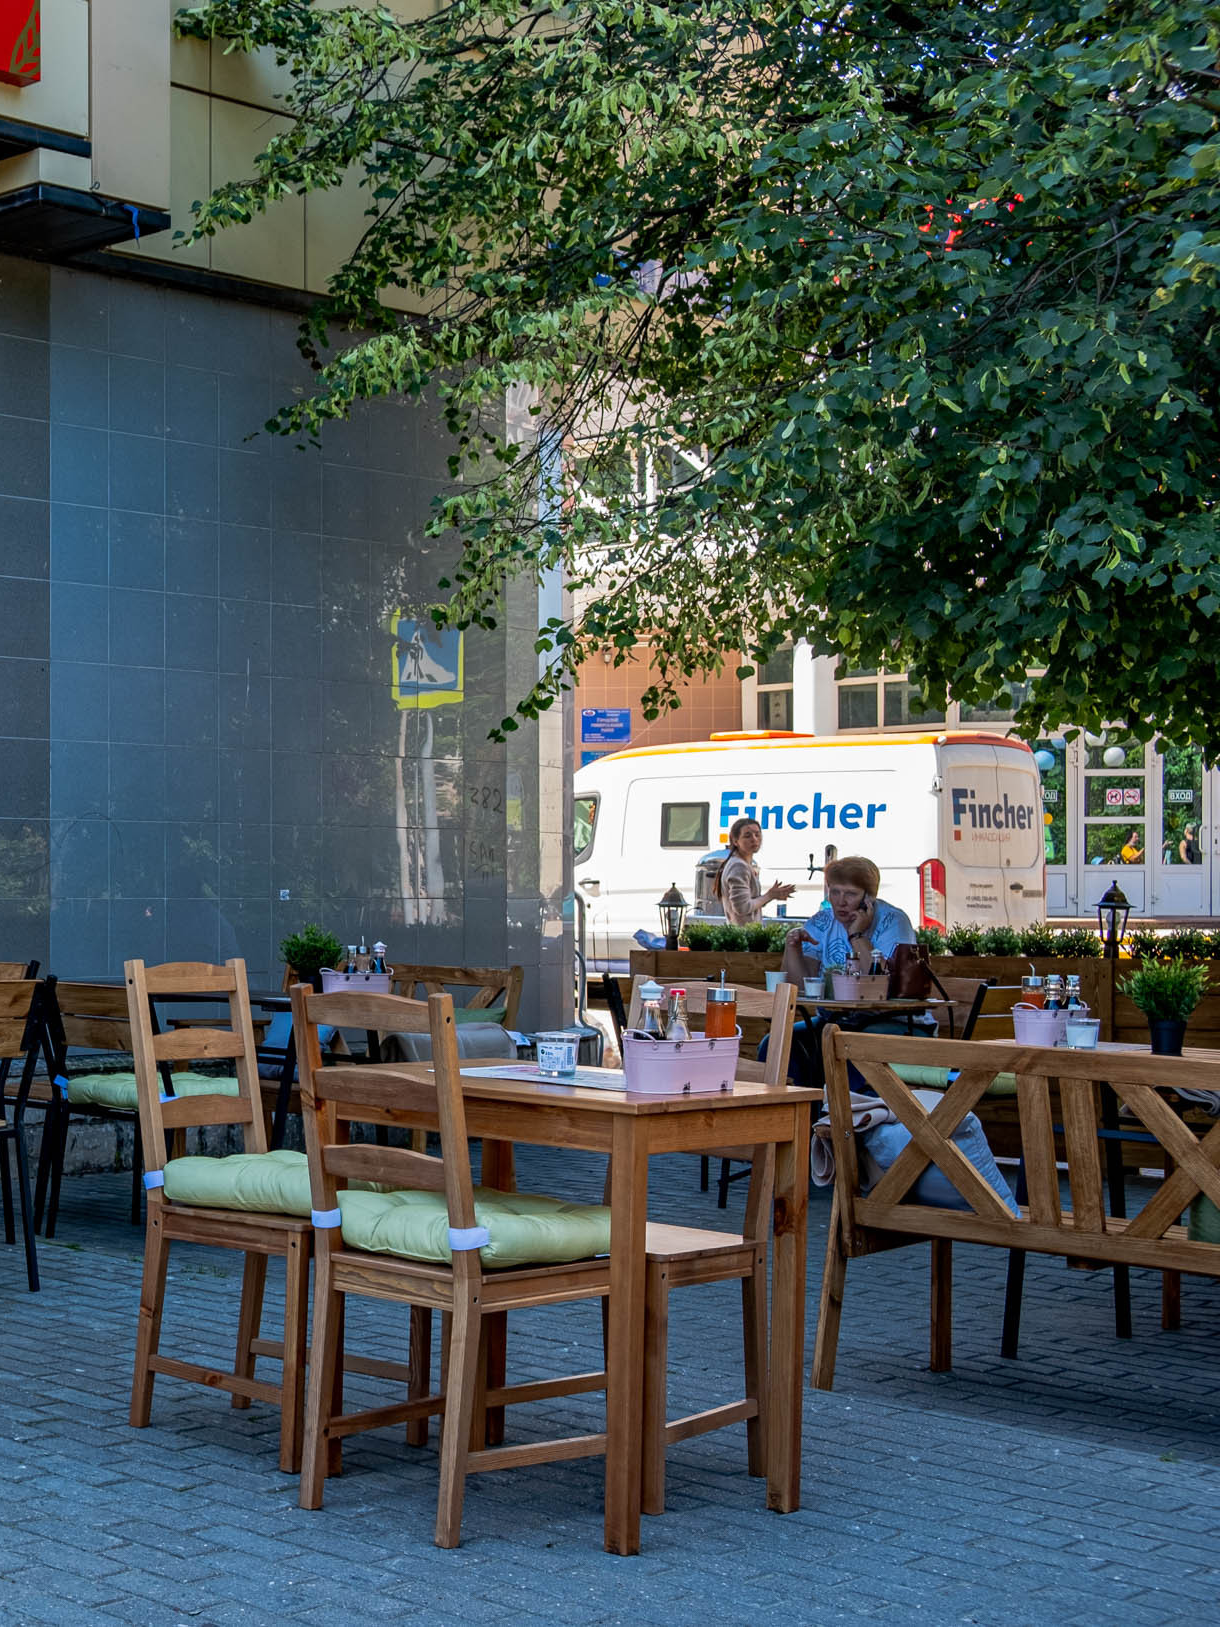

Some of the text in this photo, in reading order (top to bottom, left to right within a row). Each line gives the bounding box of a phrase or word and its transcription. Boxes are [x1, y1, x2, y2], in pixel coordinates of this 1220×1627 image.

[719, 791, 887, 830] Fincher
[951, 788, 1034, 830] Fincher
[1169, 791, 1191, 801] ВХОД
